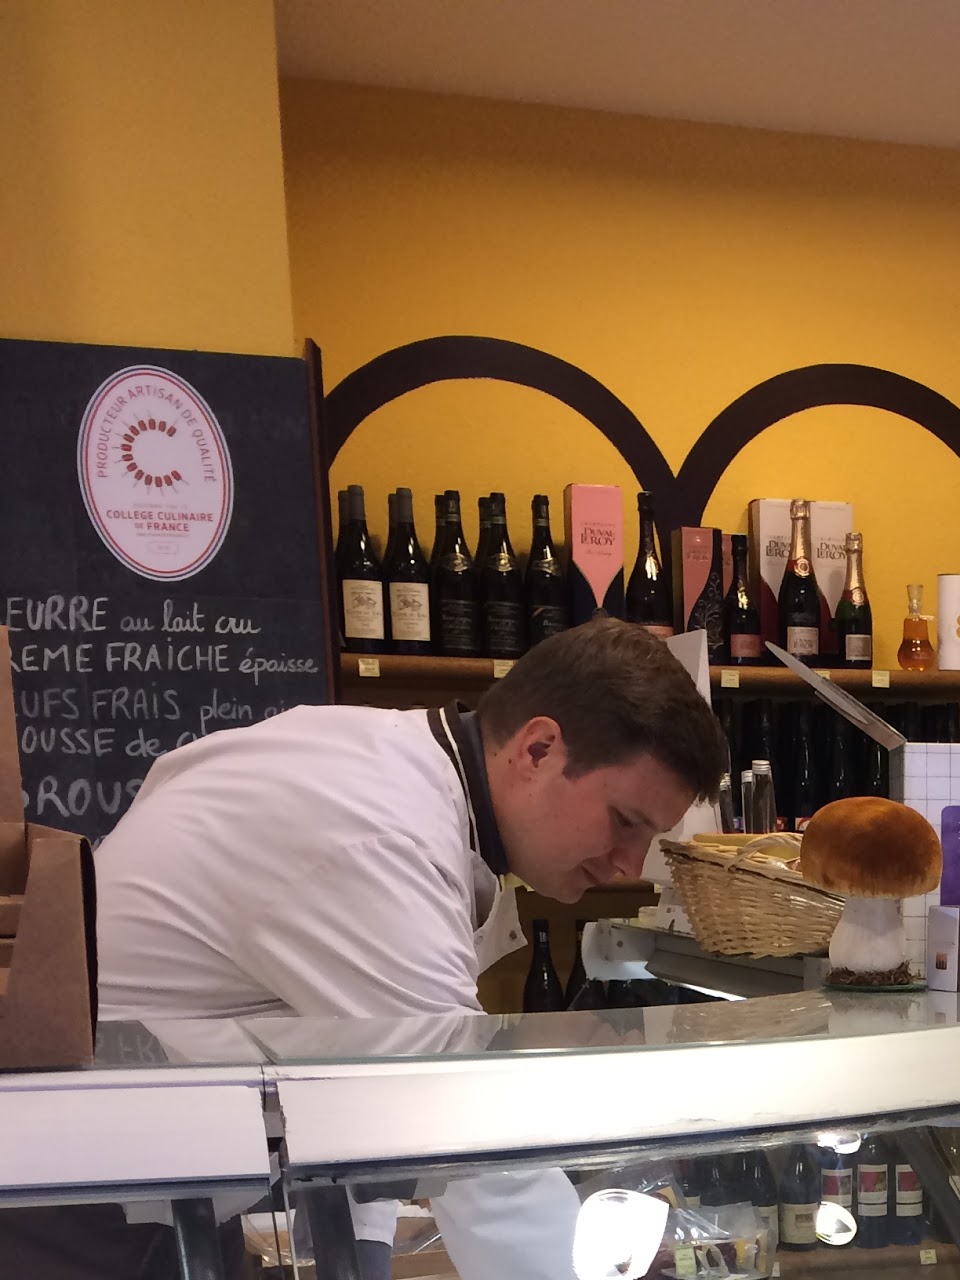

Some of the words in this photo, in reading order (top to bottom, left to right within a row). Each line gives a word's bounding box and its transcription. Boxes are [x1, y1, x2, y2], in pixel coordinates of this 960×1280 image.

[96, 395, 127, 478] PRODUCTEUR
[127, 384, 184, 411] ARTISAN
[180, 408, 198, 428] DE
[191, 428, 218, 484] QUALITÉ
[147, 522, 190, 533] FRANCE
[157, 511, 214, 523] CULINAIRE
[120, 616, 155, 632] au
[161, 598, 205, 633] lait
[214, 614, 263, 635] cru
[238, 646, 320, 687] épaisse
[15, 686, 80, 721] UFS
[200, 687, 253, 736] plein
[21, 724, 116, 758] OUSSE
